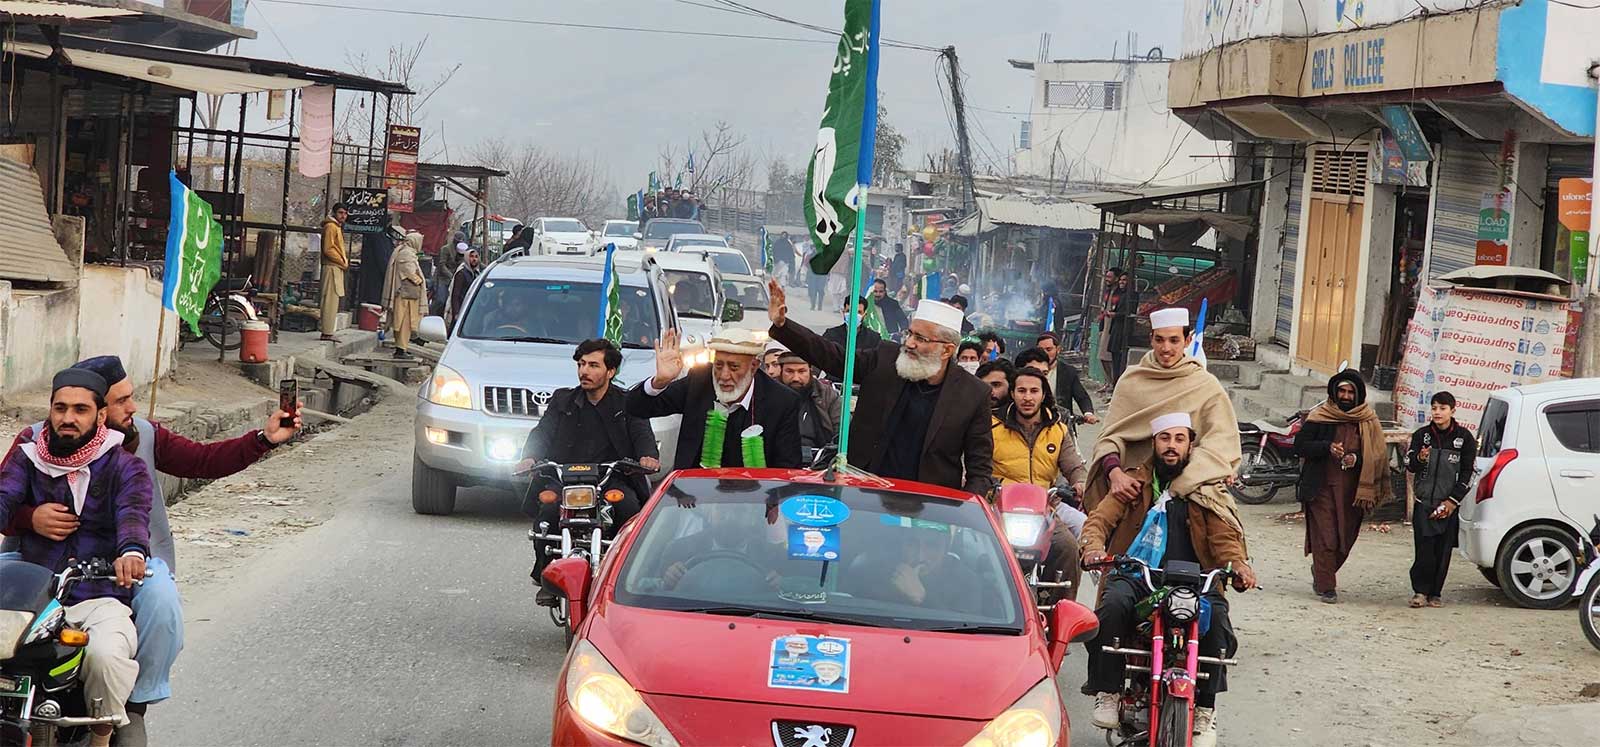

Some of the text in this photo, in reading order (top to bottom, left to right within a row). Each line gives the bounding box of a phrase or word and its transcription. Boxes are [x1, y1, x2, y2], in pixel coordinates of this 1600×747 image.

[1312, 38, 1385, 90] GIRLS COLLEGE
[1562, 193, 1585, 201] ufone
[1480, 217, 1507, 227] LOAD
[1477, 254, 1496, 262] ufone
